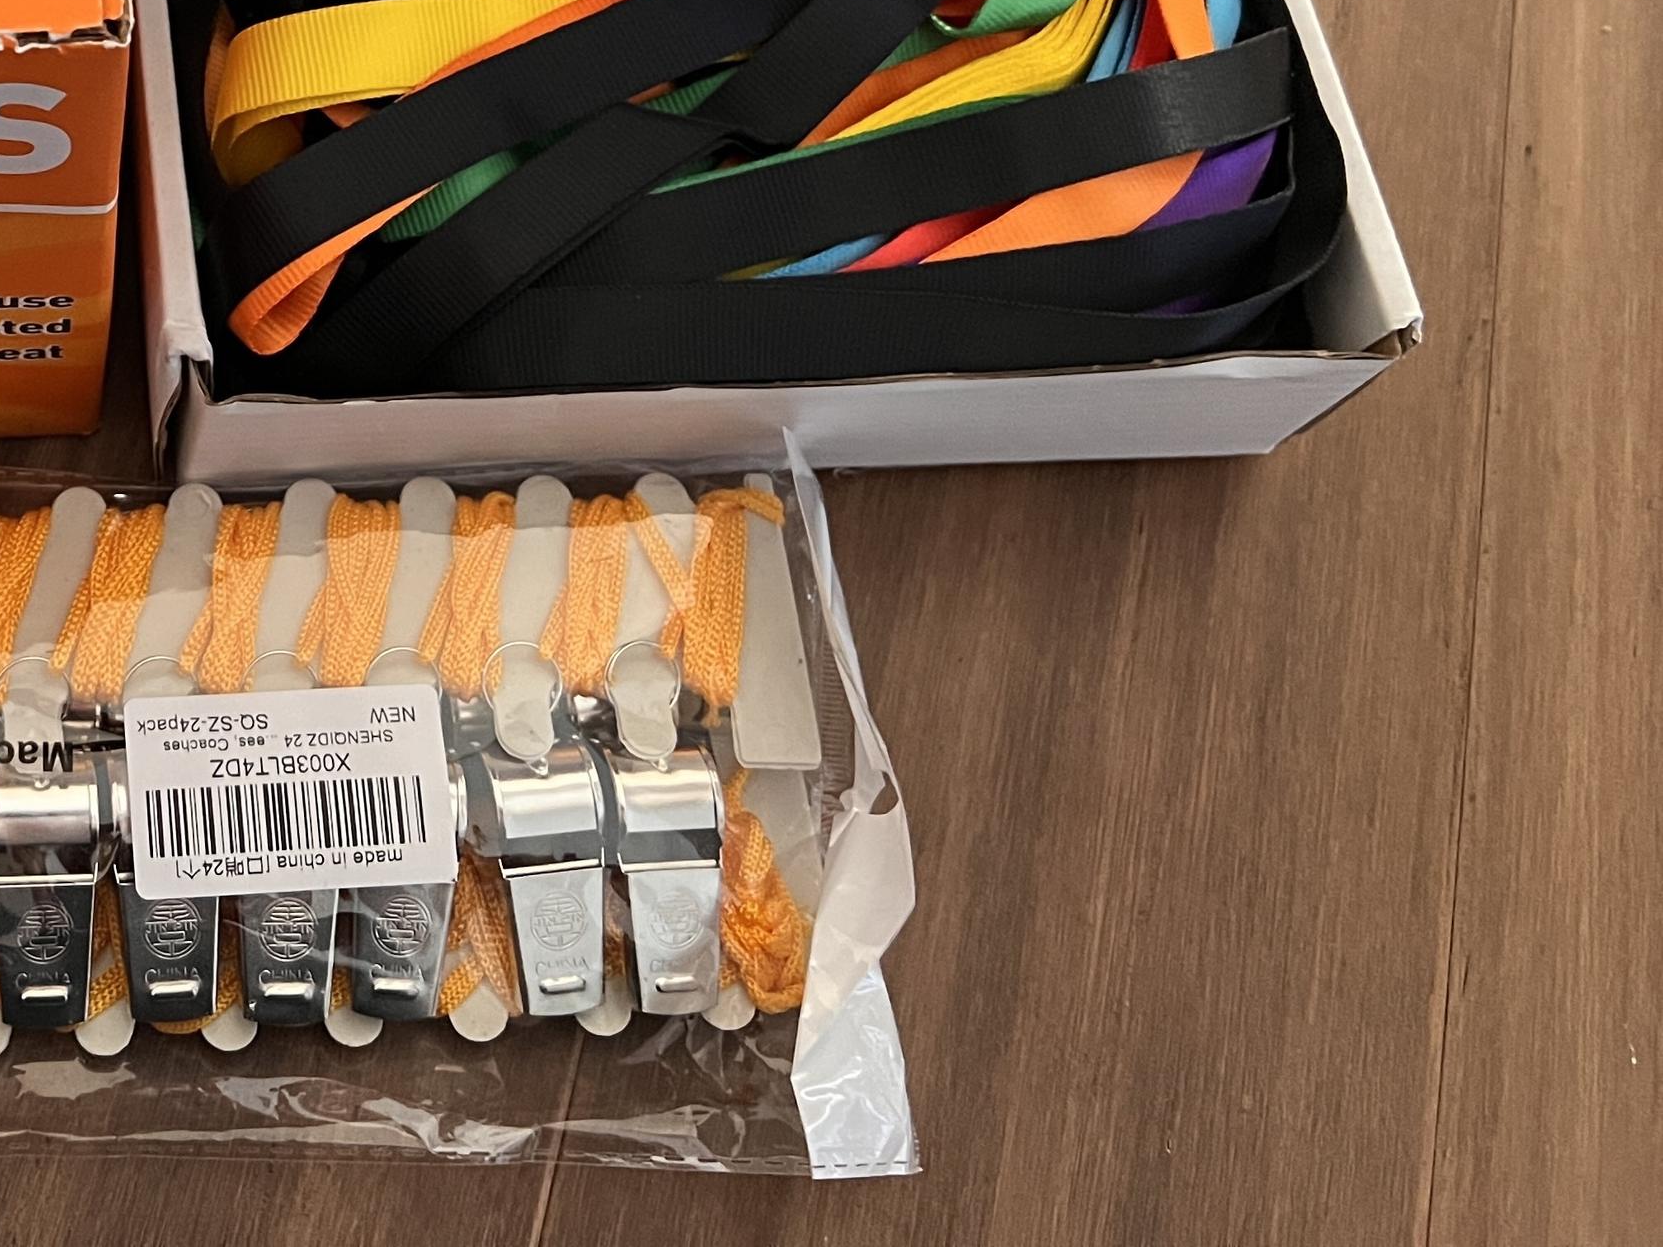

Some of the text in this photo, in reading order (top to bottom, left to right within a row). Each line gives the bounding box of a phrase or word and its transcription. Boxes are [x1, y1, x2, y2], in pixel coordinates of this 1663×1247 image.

[370, 706, 416, 724] NEW
[137, 714, 269, 735] SQ-SZ-24pack
[163, 738, 229, 752] Coaches
[284, 734, 303, 748] 24
[306, 729, 394, 747] SHENQIDZ
[211, 753, 352, 778] X003BLT4DZ
[277, 853, 325, 871] china
[332, 851, 347, 868] in
[353, 848, 403, 867] made
